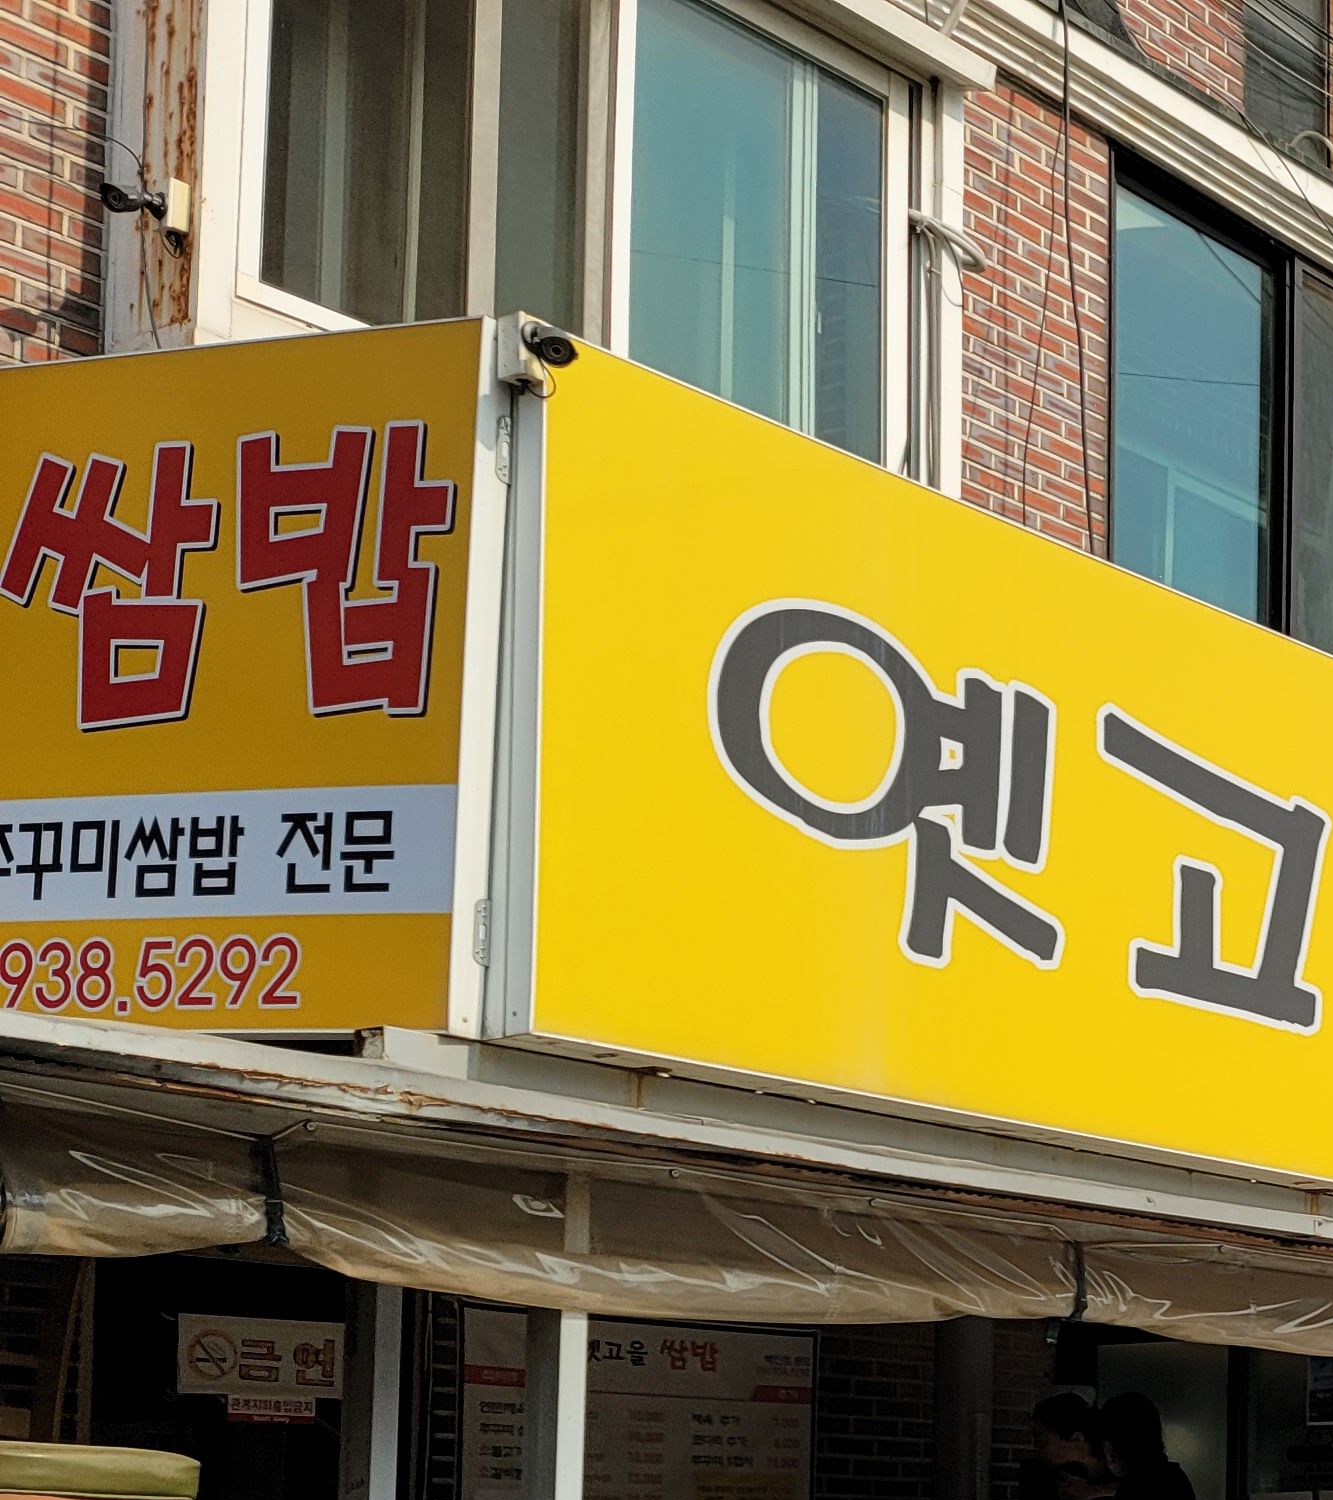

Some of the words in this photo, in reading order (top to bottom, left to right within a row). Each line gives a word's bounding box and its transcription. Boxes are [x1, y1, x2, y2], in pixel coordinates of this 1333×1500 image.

[0, 419, 456, 733] 쌈밥
[0, 815, 246, 901] 꾸미쌈밥
[276, 810, 396, 895] 전문
[238, 1338, 336, 1388] 금연
